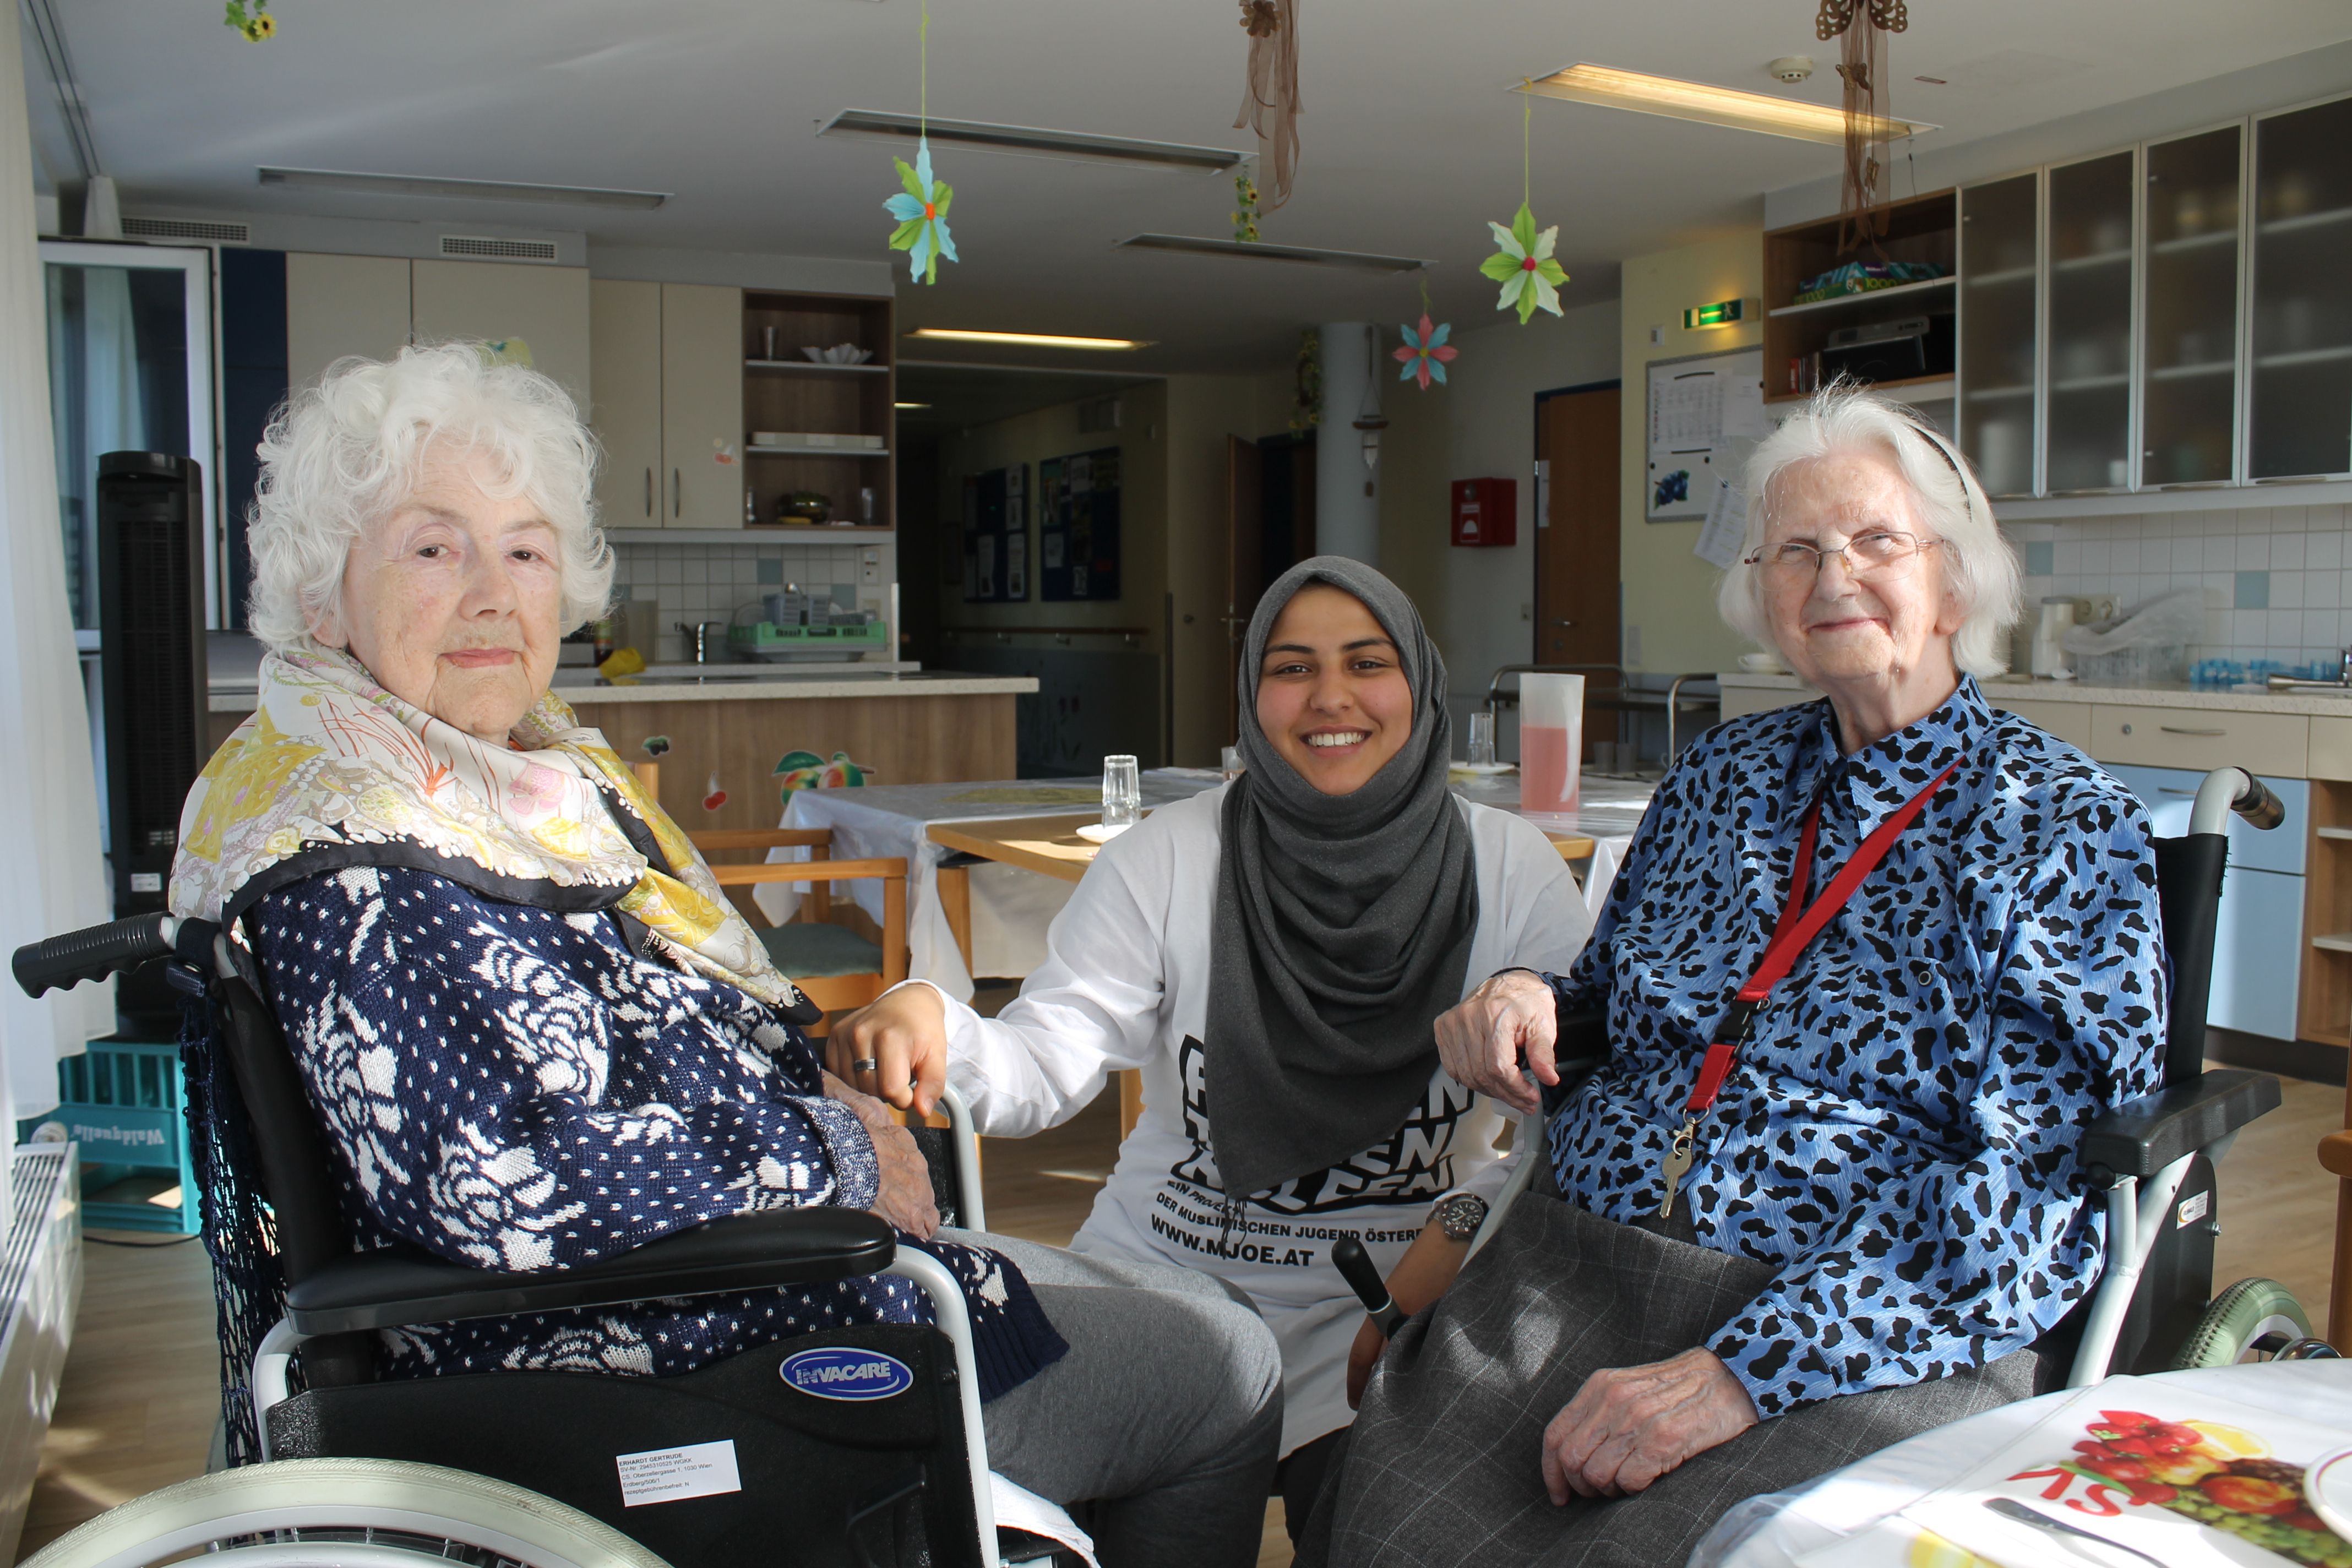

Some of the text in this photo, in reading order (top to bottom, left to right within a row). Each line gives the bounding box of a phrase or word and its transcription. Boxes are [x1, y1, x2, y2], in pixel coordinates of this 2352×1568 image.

[73, 1124, 165, 1146] Waldquelle
[1167, 1180, 1239, 1214] EIN PROJE
[1156, 1192, 1178, 1212] DER
[1295, 1227, 1360, 1240] JUGEND
[1151, 1213, 1314, 1267] WWW.MJOE.AT
[796, 1362, 891, 1385] INVACARE
[619, 1452, 683, 1466] ERHARDT GERTRUDE
